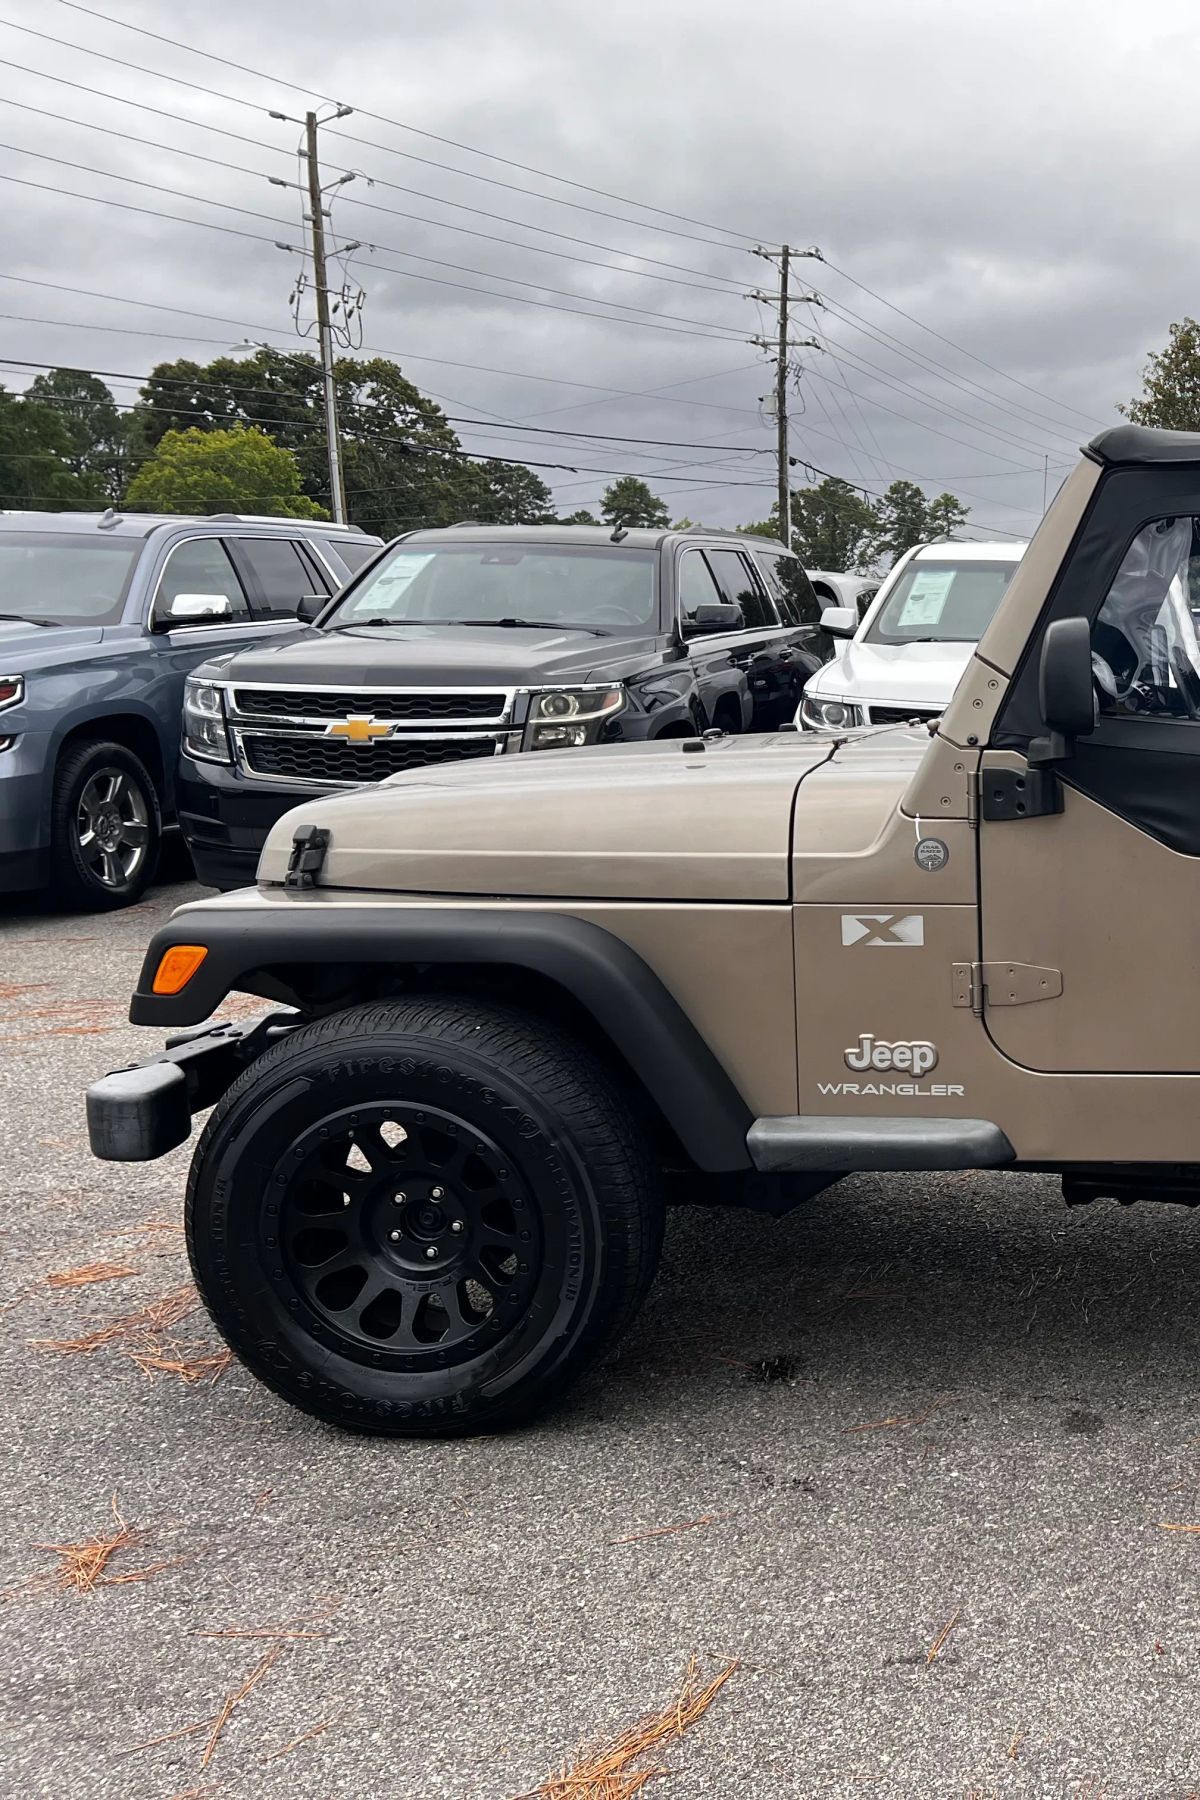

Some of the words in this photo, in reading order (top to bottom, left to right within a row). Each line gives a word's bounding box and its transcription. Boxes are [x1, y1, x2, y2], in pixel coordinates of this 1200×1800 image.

[845, 915, 912, 946] X
[847, 1037, 935, 1075] Jeep
[320, 1055, 497, 1105] Firestone
[816, 1083, 965, 1097] WRANGLER
